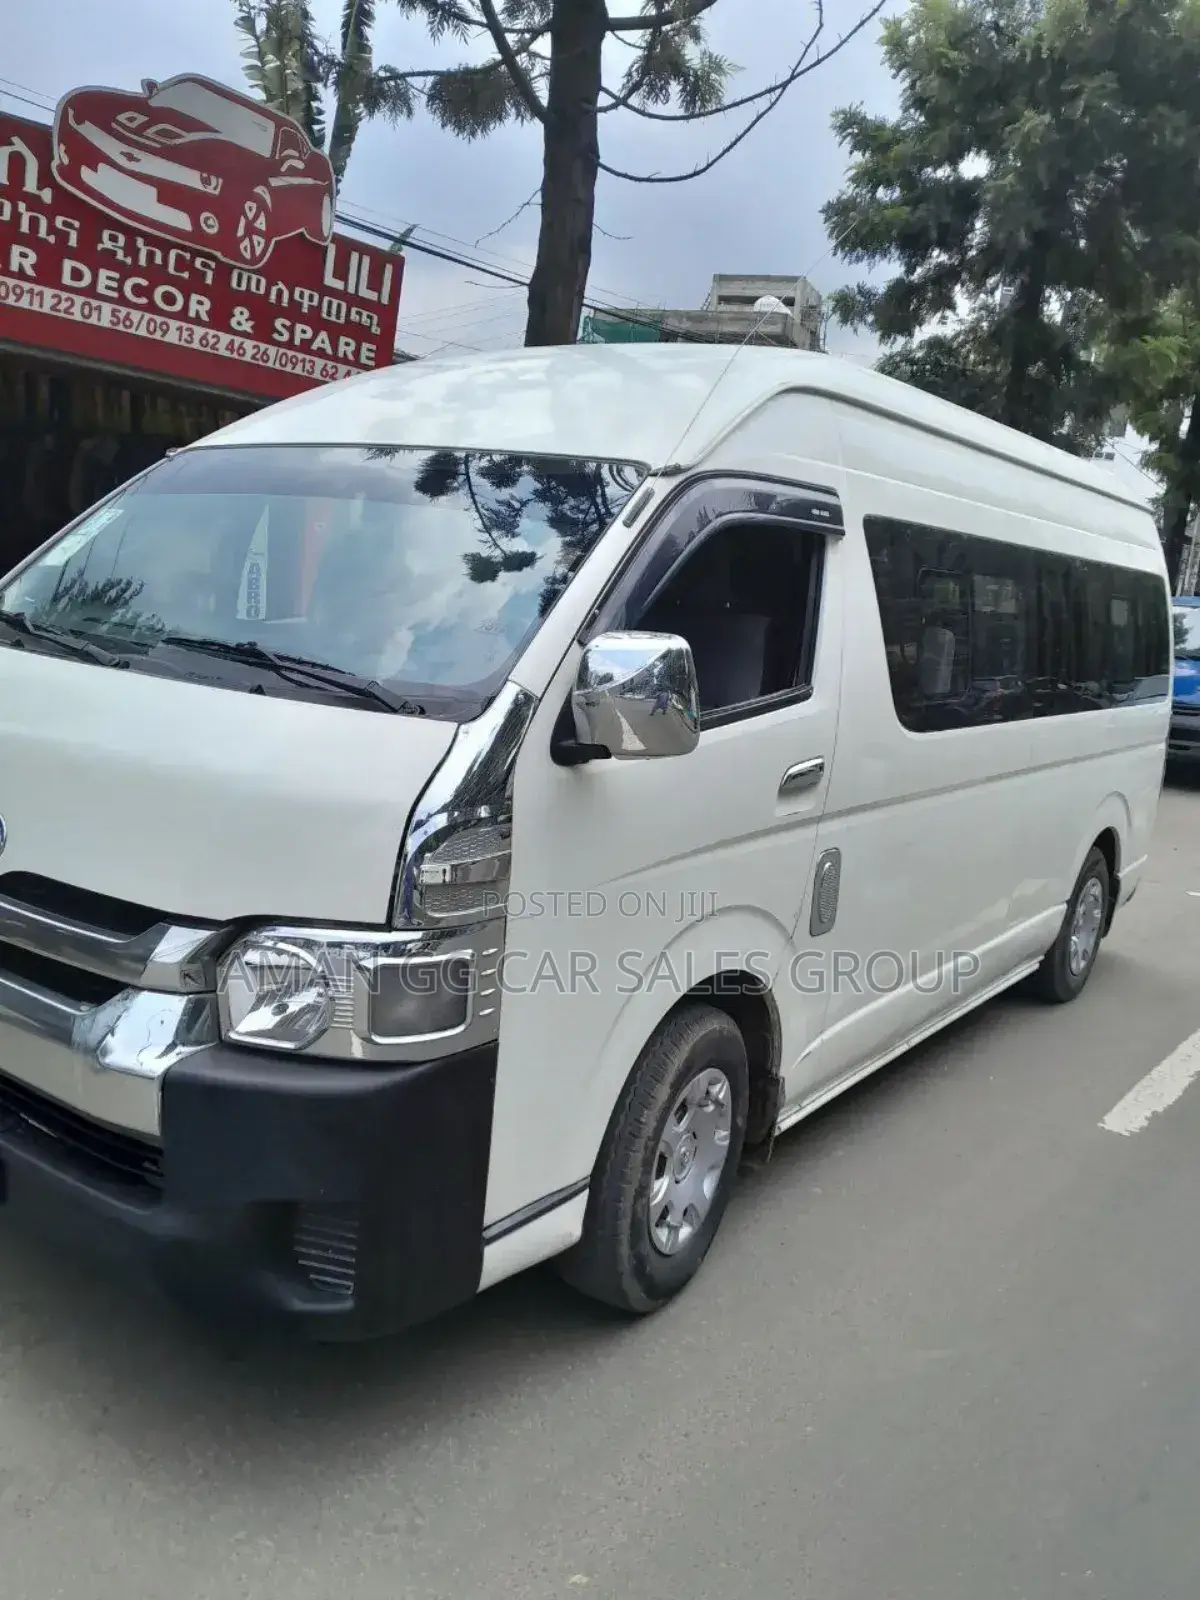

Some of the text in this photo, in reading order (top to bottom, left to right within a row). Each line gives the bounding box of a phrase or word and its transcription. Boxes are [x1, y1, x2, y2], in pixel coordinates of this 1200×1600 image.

[61, 258, 211, 321] DECOR
[229, 306, 255, 334] &
[271, 317, 377, 366] SPARE
[323, 243, 393, 305] LILI
[0, 280, 45, 309] 0911
[50, 293, 75, 316] 22
[80, 300, 103, 322] 01
[176, 326, 194, 345] 13
[199, 331, 220, 351] 62
[225, 338, 246, 358] 46
